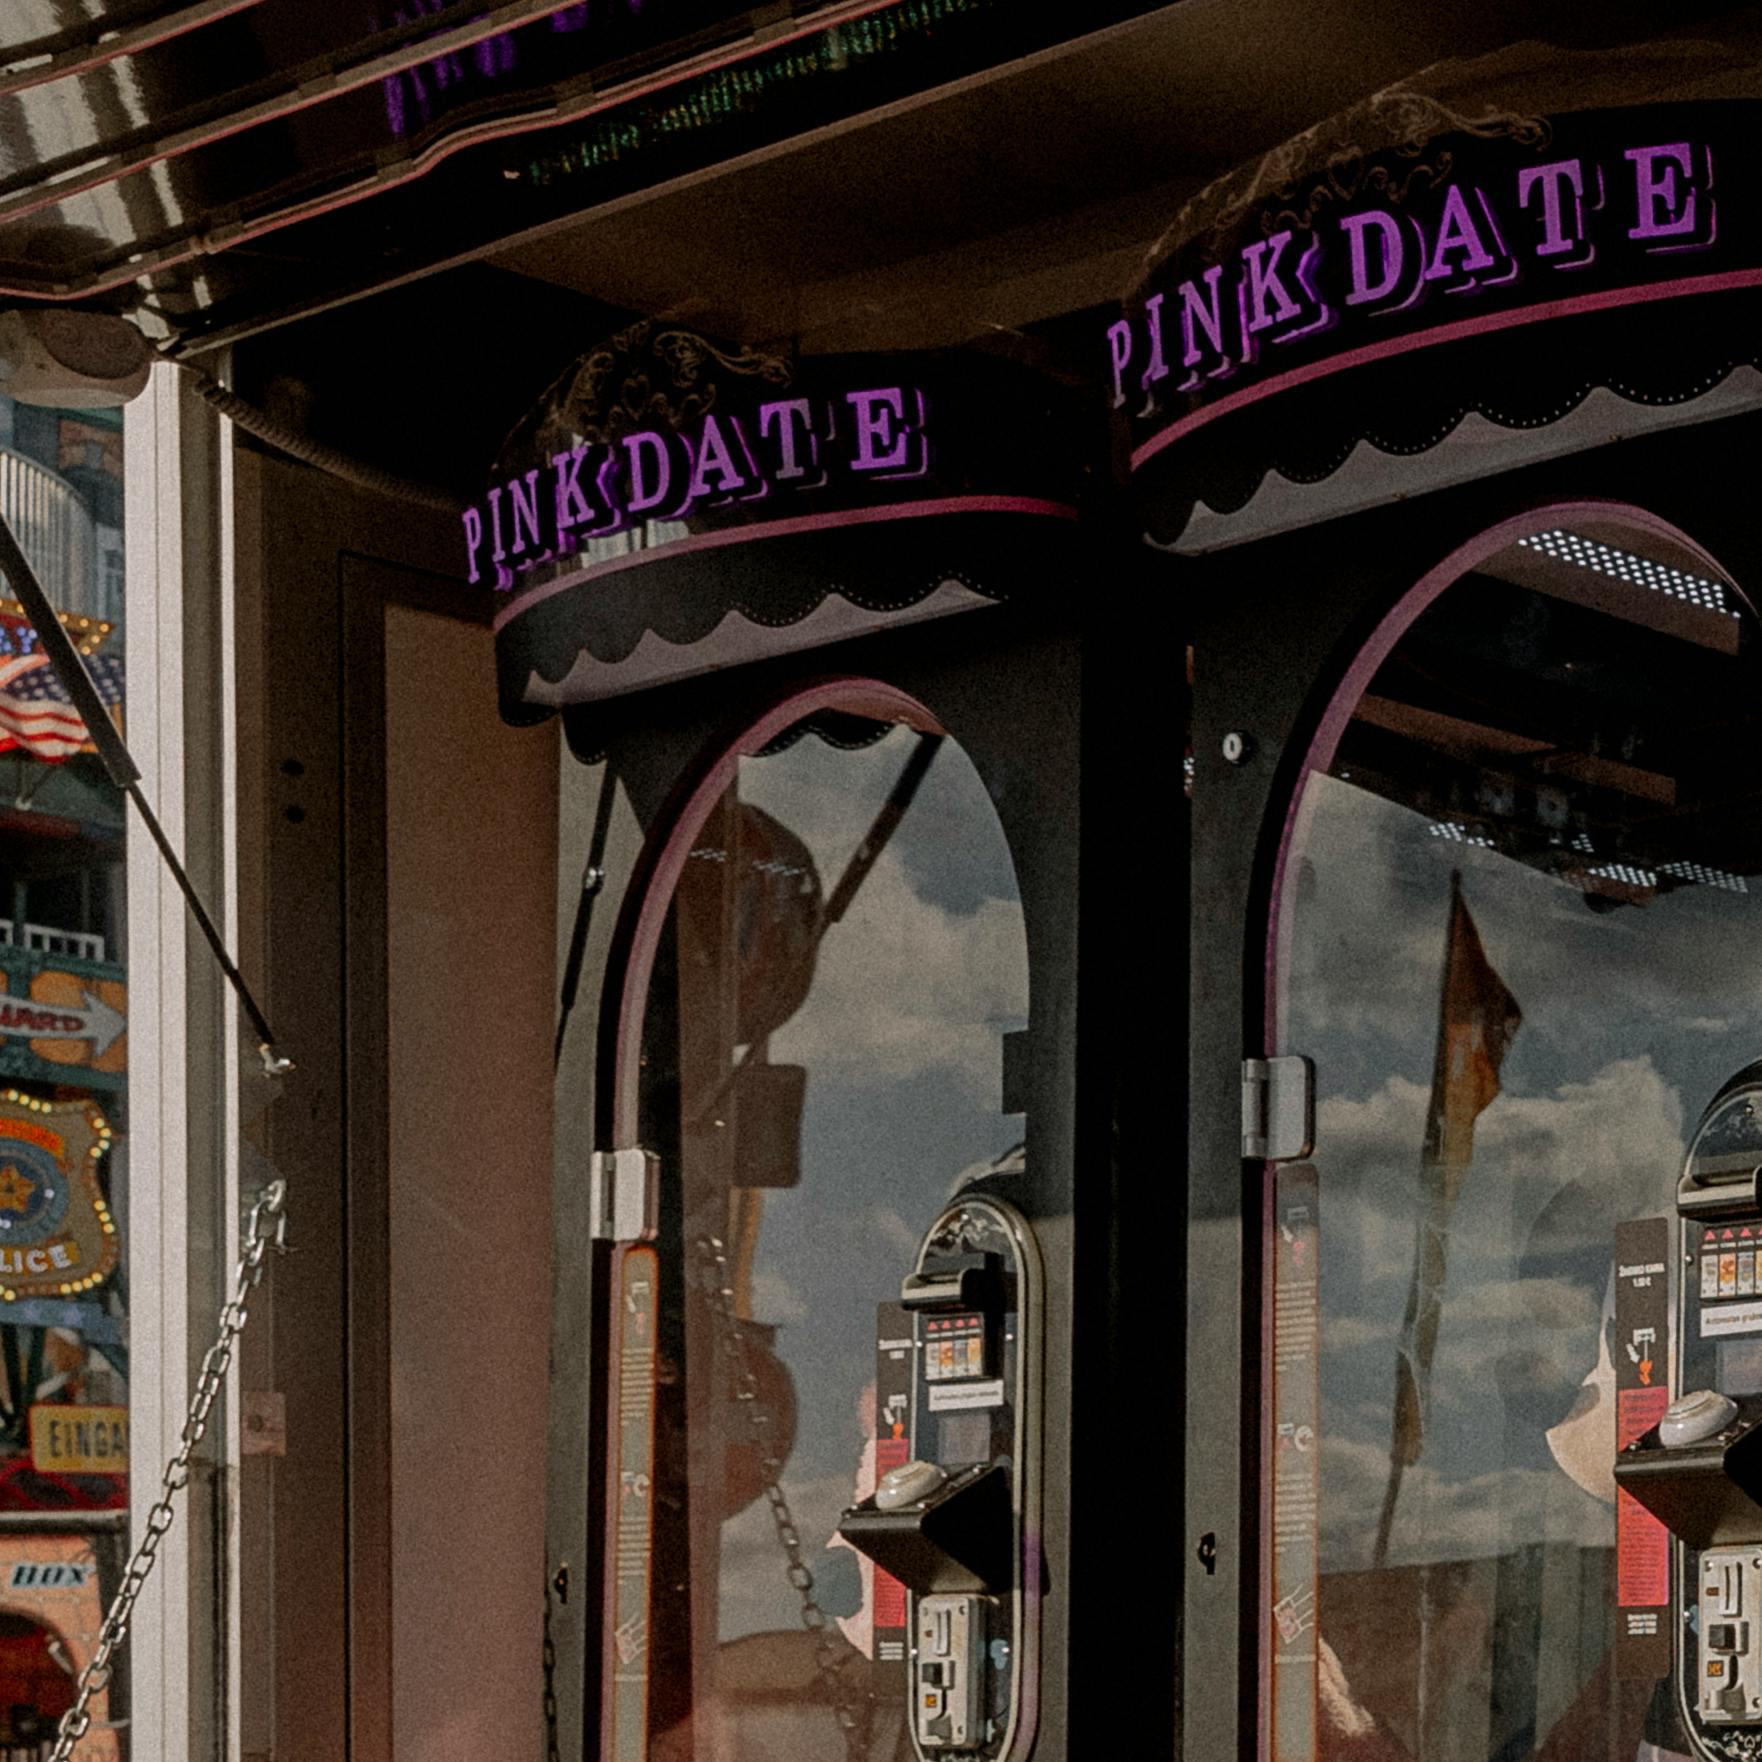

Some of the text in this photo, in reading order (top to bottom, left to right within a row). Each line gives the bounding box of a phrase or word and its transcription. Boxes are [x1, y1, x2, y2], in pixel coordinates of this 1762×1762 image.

[1105, 142, 1698, 409] PINK DATE
[461, 386, 922, 586] PINK DATE
